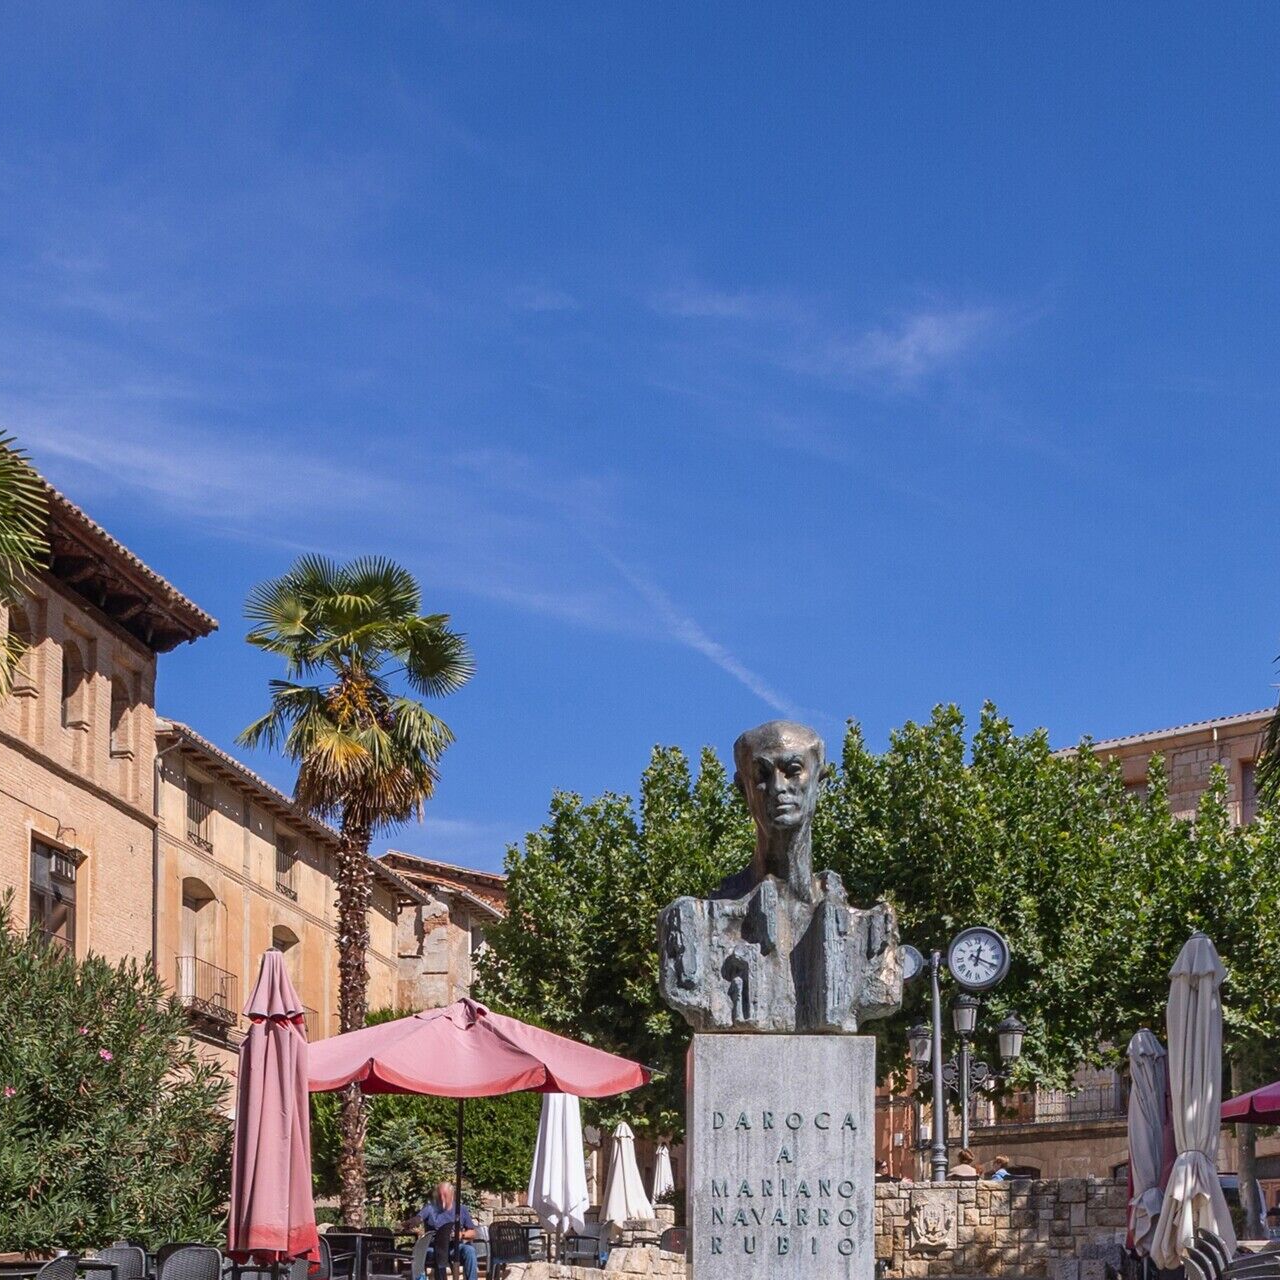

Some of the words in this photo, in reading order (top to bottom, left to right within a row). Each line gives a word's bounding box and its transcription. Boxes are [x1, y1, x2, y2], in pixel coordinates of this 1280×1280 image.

[712, 1111, 857, 1131] DAROCA
[776, 1145, 793, 1163] A
[711, 1179, 856, 1199] MARIANO
[711, 1207, 857, 1227] NAVARRO
[711, 1236, 856, 1256] RUBIO
